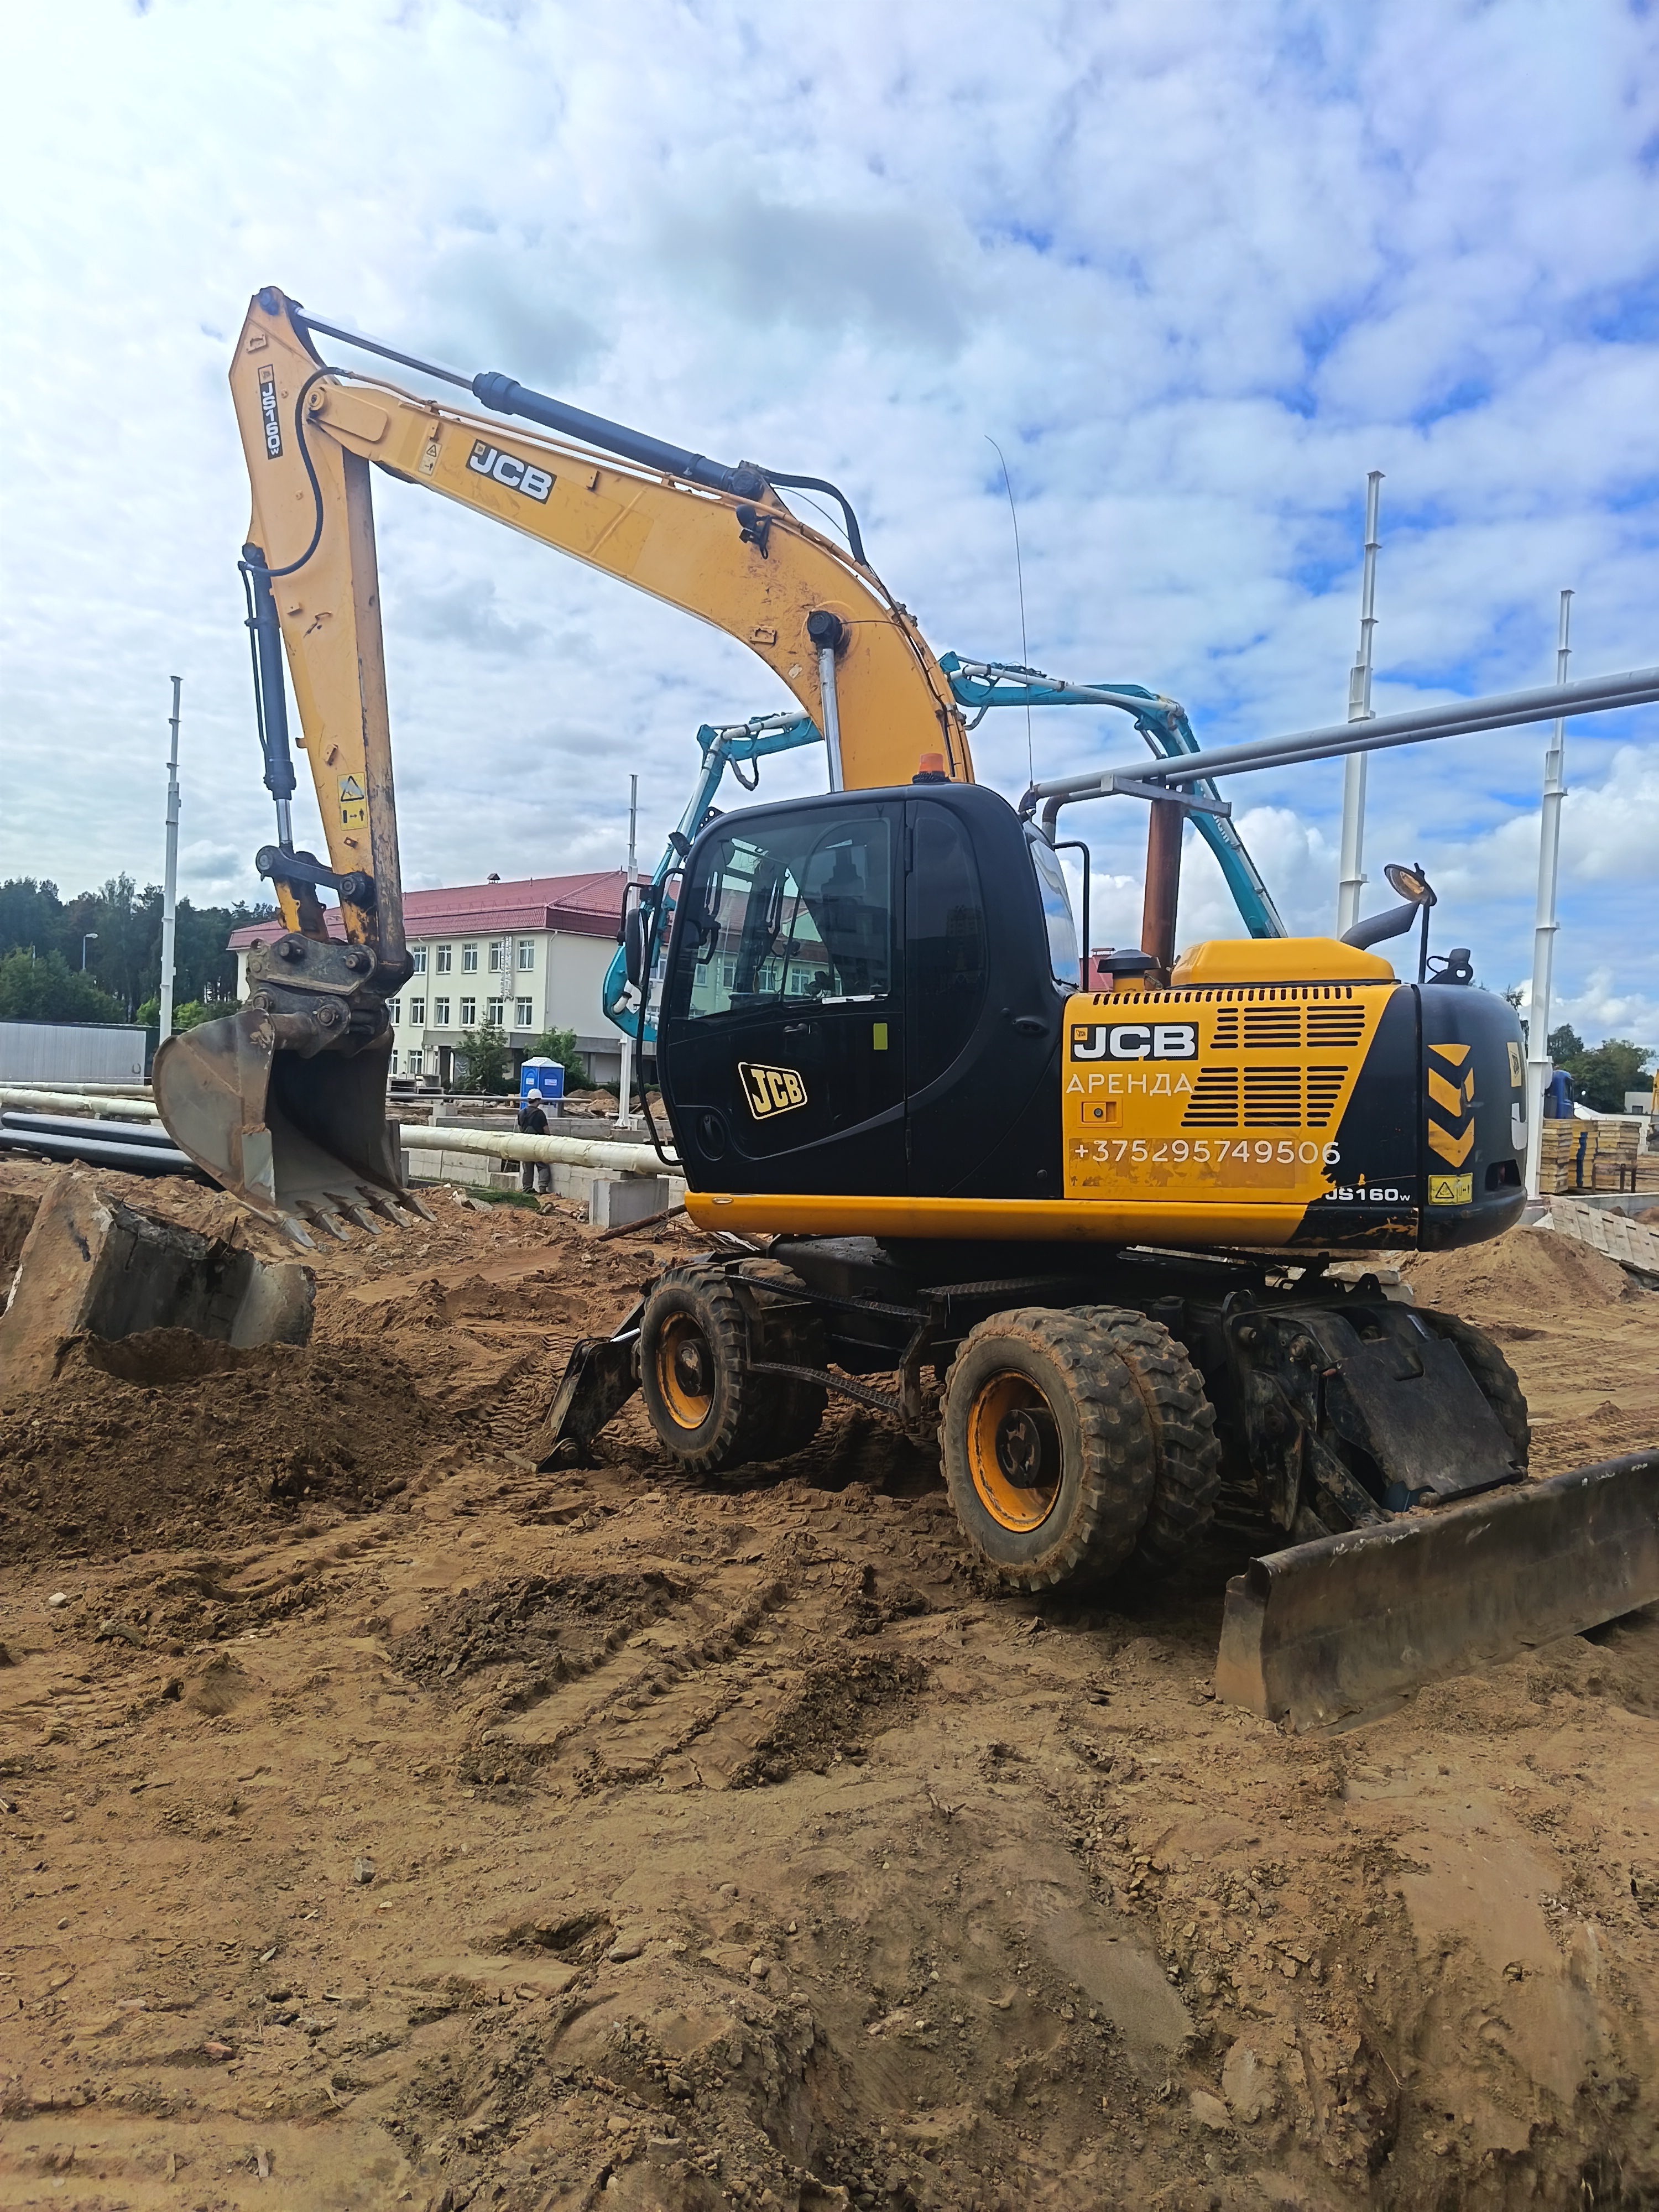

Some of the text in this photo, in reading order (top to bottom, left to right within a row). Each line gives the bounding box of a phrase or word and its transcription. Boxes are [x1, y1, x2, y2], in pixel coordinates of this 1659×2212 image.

[469, 448, 552, 500] JCB
[1074, 1025, 1196, 1058] JCB
[750, 1068, 802, 1113] JCB
[1066, 1073, 1194, 1097] АРЕНДА
[1074, 1140, 1341, 1165] +375295749506
